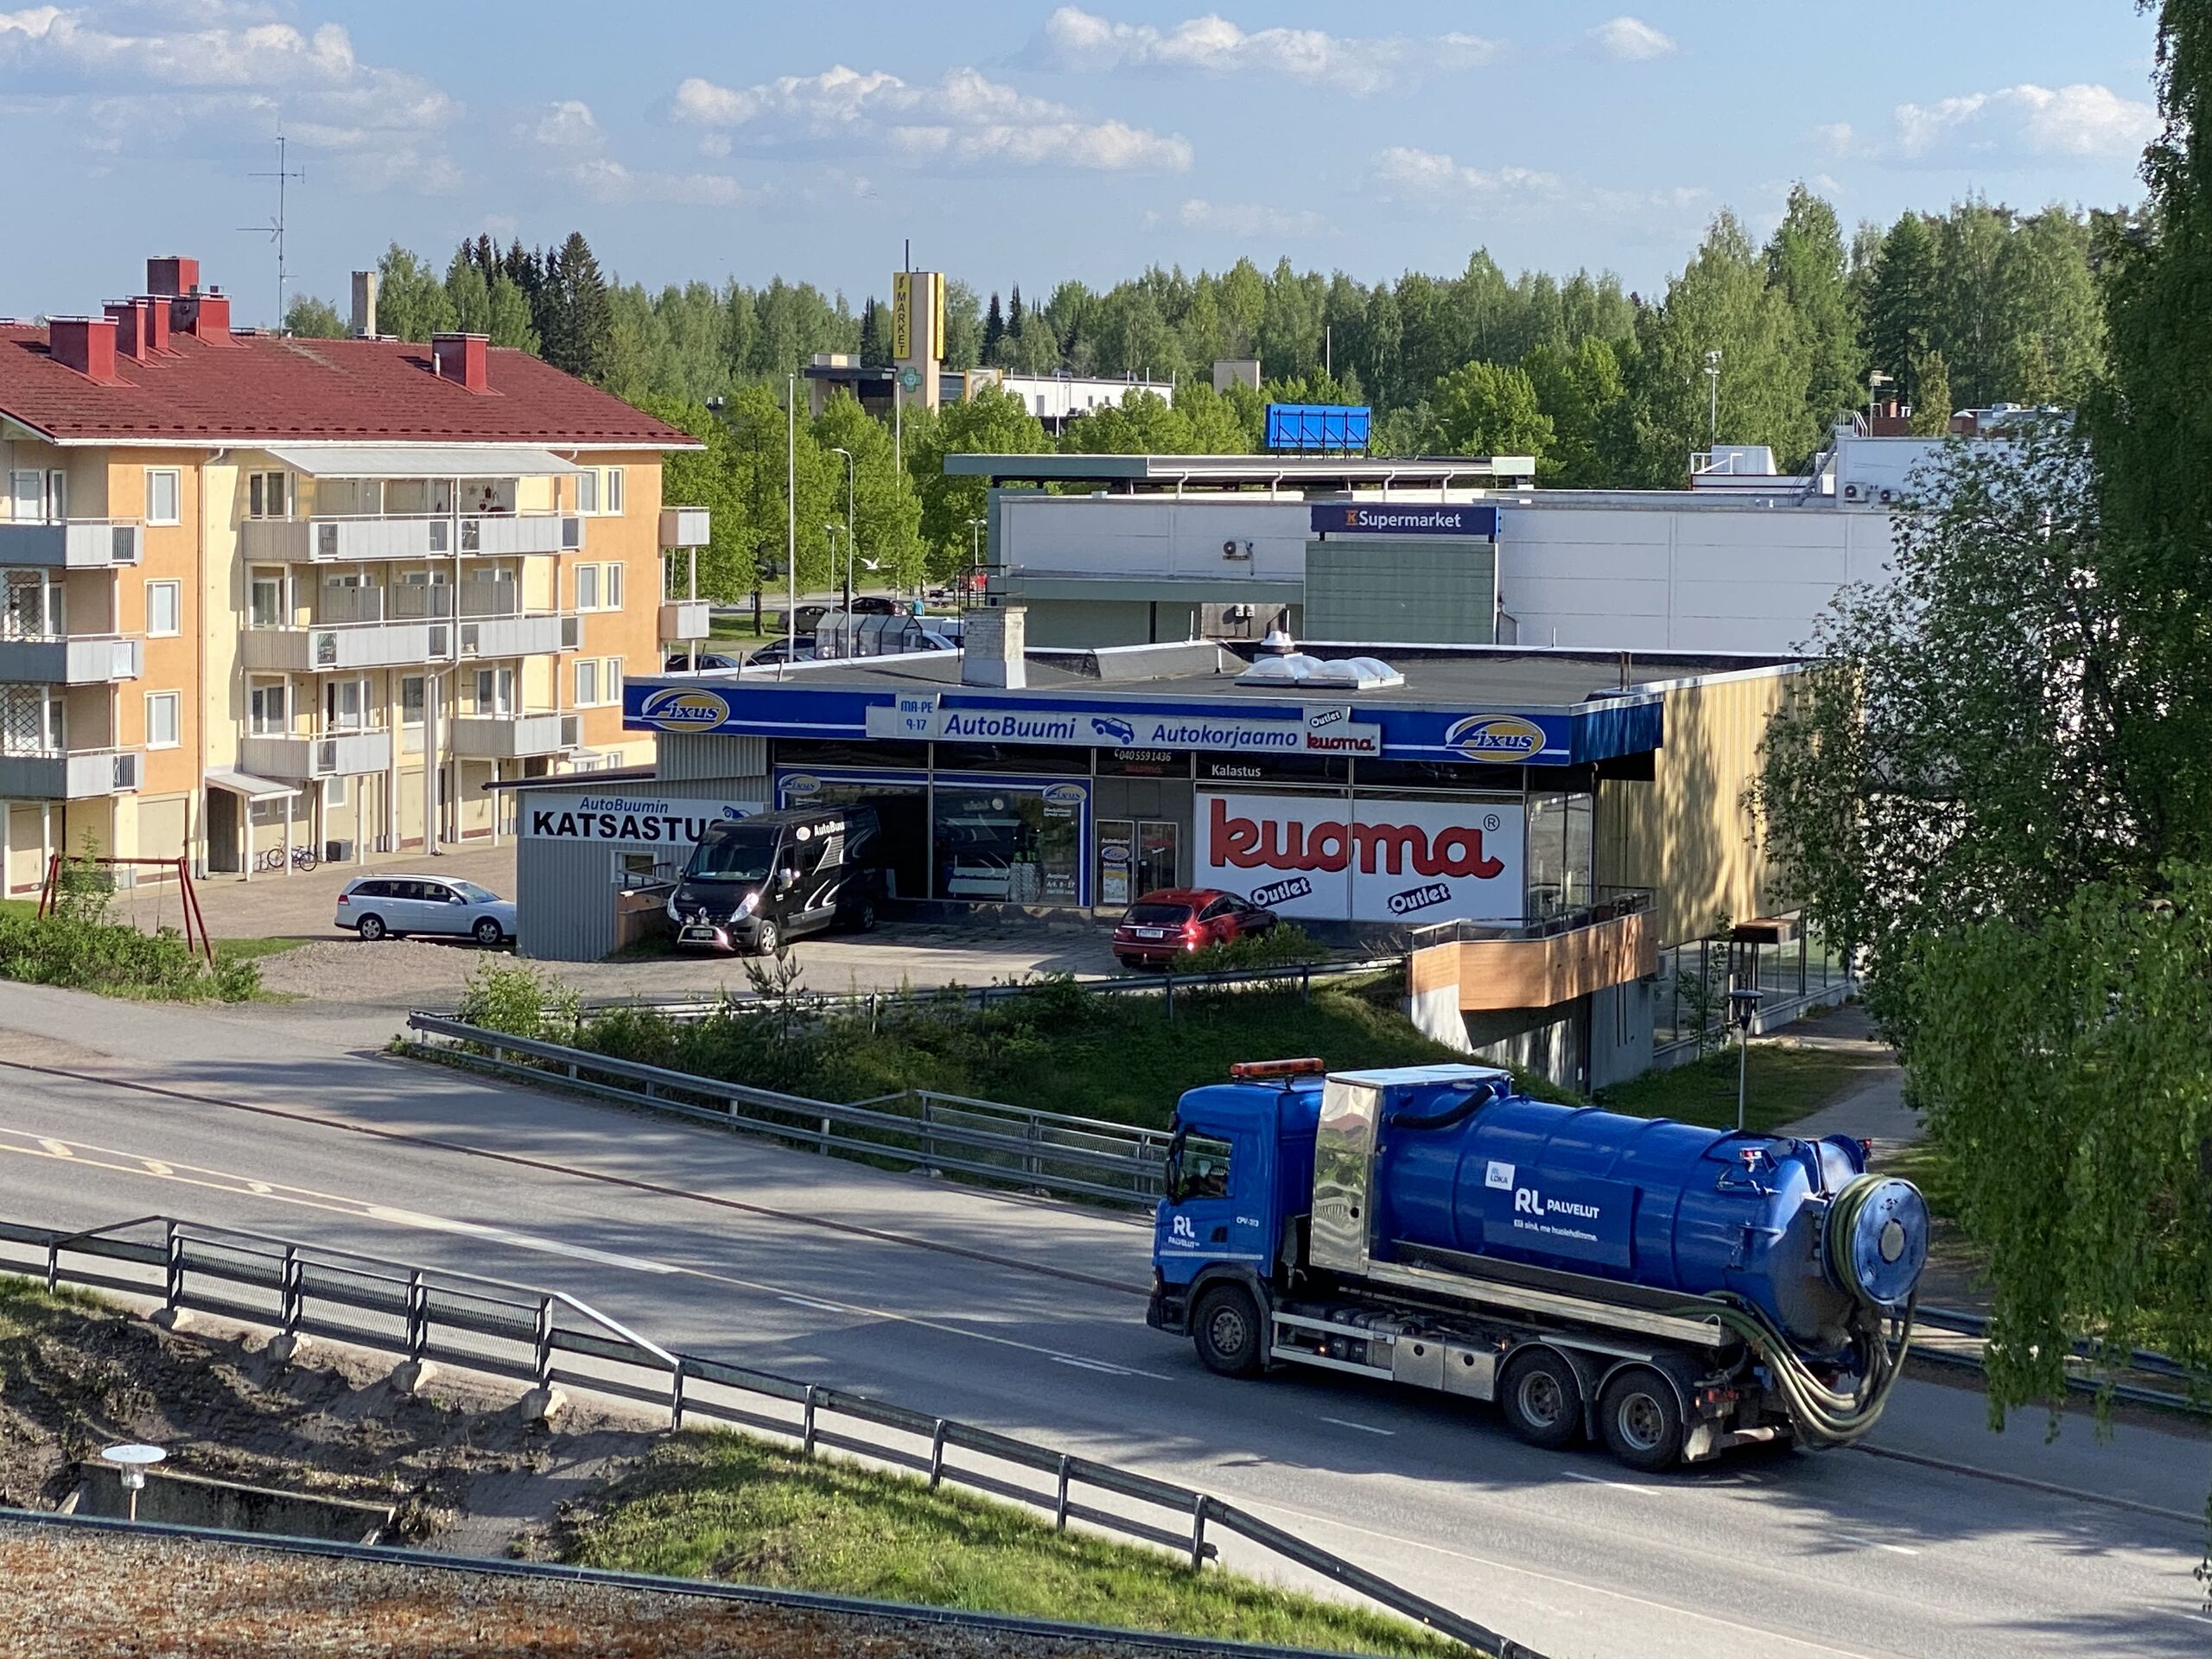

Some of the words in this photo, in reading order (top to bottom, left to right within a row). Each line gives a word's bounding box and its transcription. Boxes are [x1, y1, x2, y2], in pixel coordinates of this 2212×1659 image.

[897, 292, 906, 355] MARKET
[1359, 511, 1461, 529] Supermarket
[645, 694, 720, 721] Fixus
[900, 701, 934, 714] MA-PE
[1310, 711, 1340, 728] Outlet
[906, 718, 927, 732] 9-17
[944, 714, 1077, 739] AutoBuumi
[1152, 724, 1298, 748] Autokorjaamo
[1446, 721, 1535, 750] Fixus
[1306, 733, 1376, 751] kuoma
[1211, 764, 1262, 777] Kalastus
[580, 797, 669, 814] AutoBuumin
[533, 810, 726, 843] KATSASTU
[814, 820, 854, 836] AutoBuu
[1211, 798, 1504, 879] kuoma
[1253, 877, 1311, 907] Outlet
[1389, 884, 1451, 913] Outlet
[1515, 1187, 1544, 1216] RL
[1547, 1198, 1599, 1219] PALVELUT
[1173, 1215, 1195, 1238] RL
